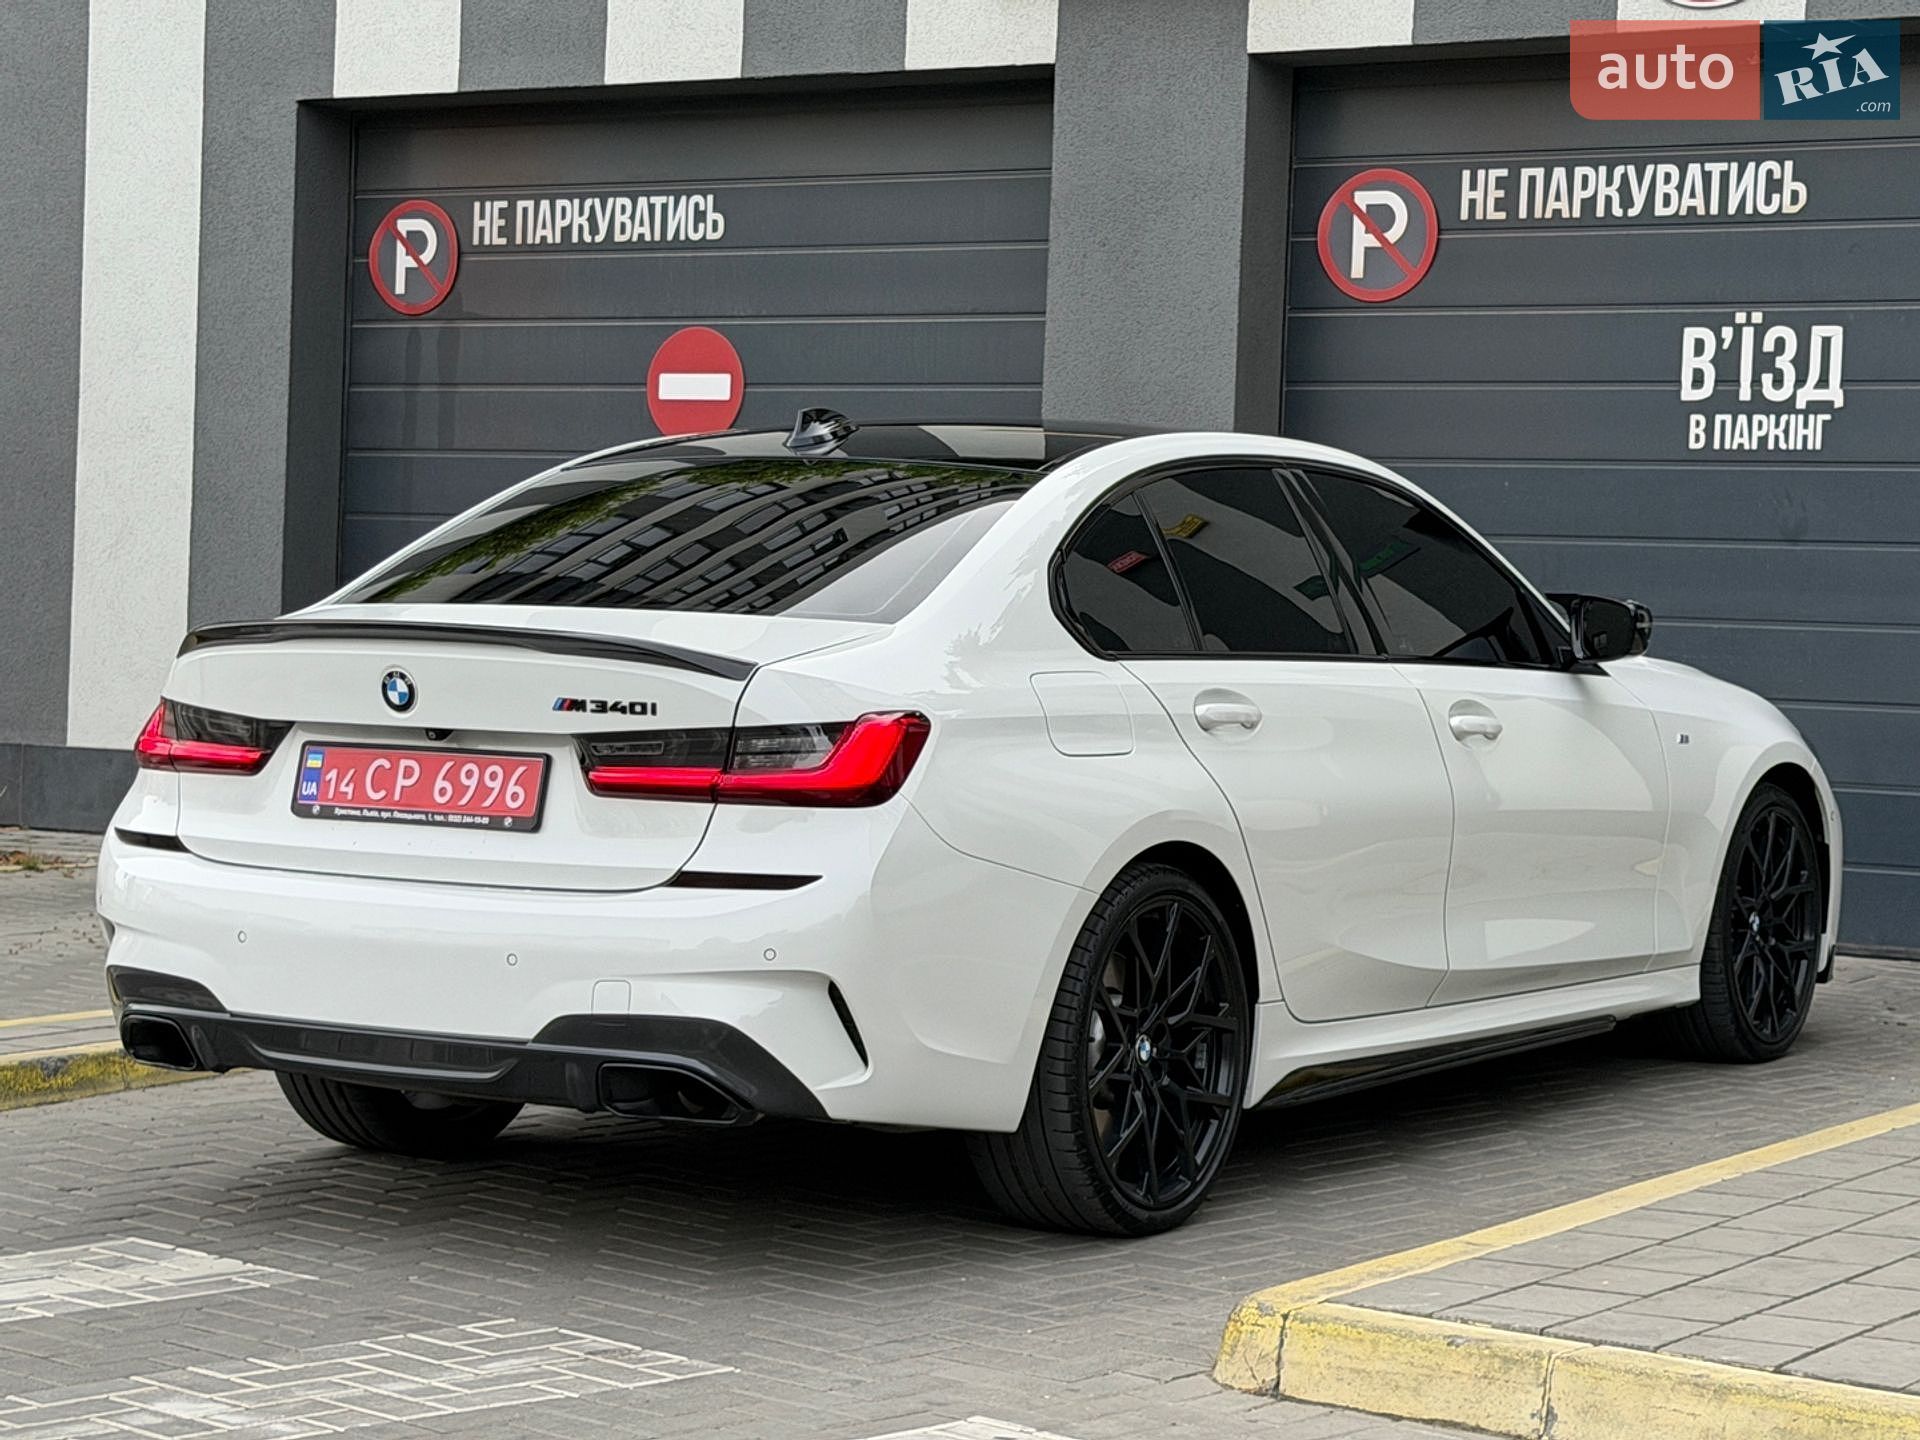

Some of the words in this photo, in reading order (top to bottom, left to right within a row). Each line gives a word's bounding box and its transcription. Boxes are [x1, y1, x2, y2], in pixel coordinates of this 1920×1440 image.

[1459, 167, 1509, 221] НЕ
[1518, 160, 1808, 219] ПАРКУВАТИСЬ
[472, 200, 508, 246] НЕ
[515, 194, 725, 245] ПАРКУВАТИСЬ
[1680, 312, 1844, 409] В'ЇЗД
[1688, 414, 1706, 450] В
[1713, 413, 1832, 450] ПАРКІНГ
[302, 781, 317, 796] UA
[325, 768, 356, 800] 14
[433, 761, 528, 809] 6996
